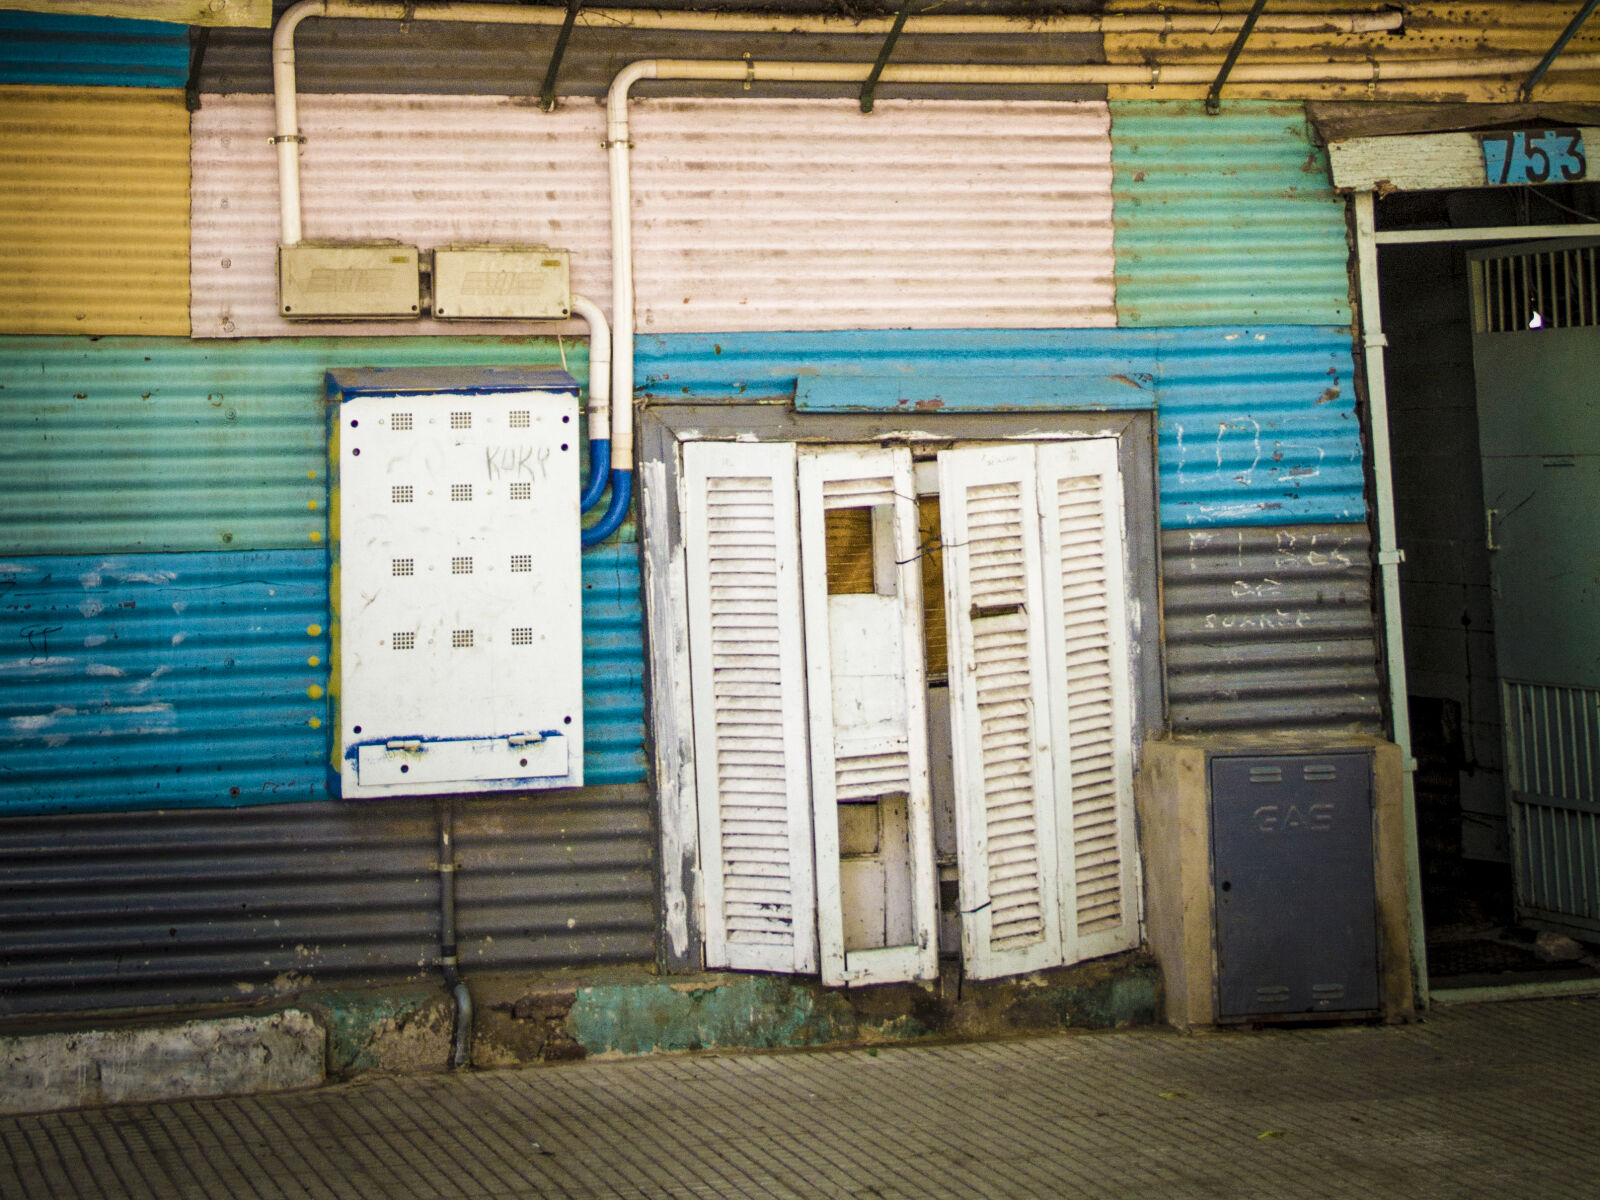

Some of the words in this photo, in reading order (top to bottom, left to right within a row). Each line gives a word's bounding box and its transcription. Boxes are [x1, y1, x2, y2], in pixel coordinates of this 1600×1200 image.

[1479, 129, 1587, 184] 753
[486, 444, 551, 482] KUKY
[1252, 803, 1336, 833] GAS
